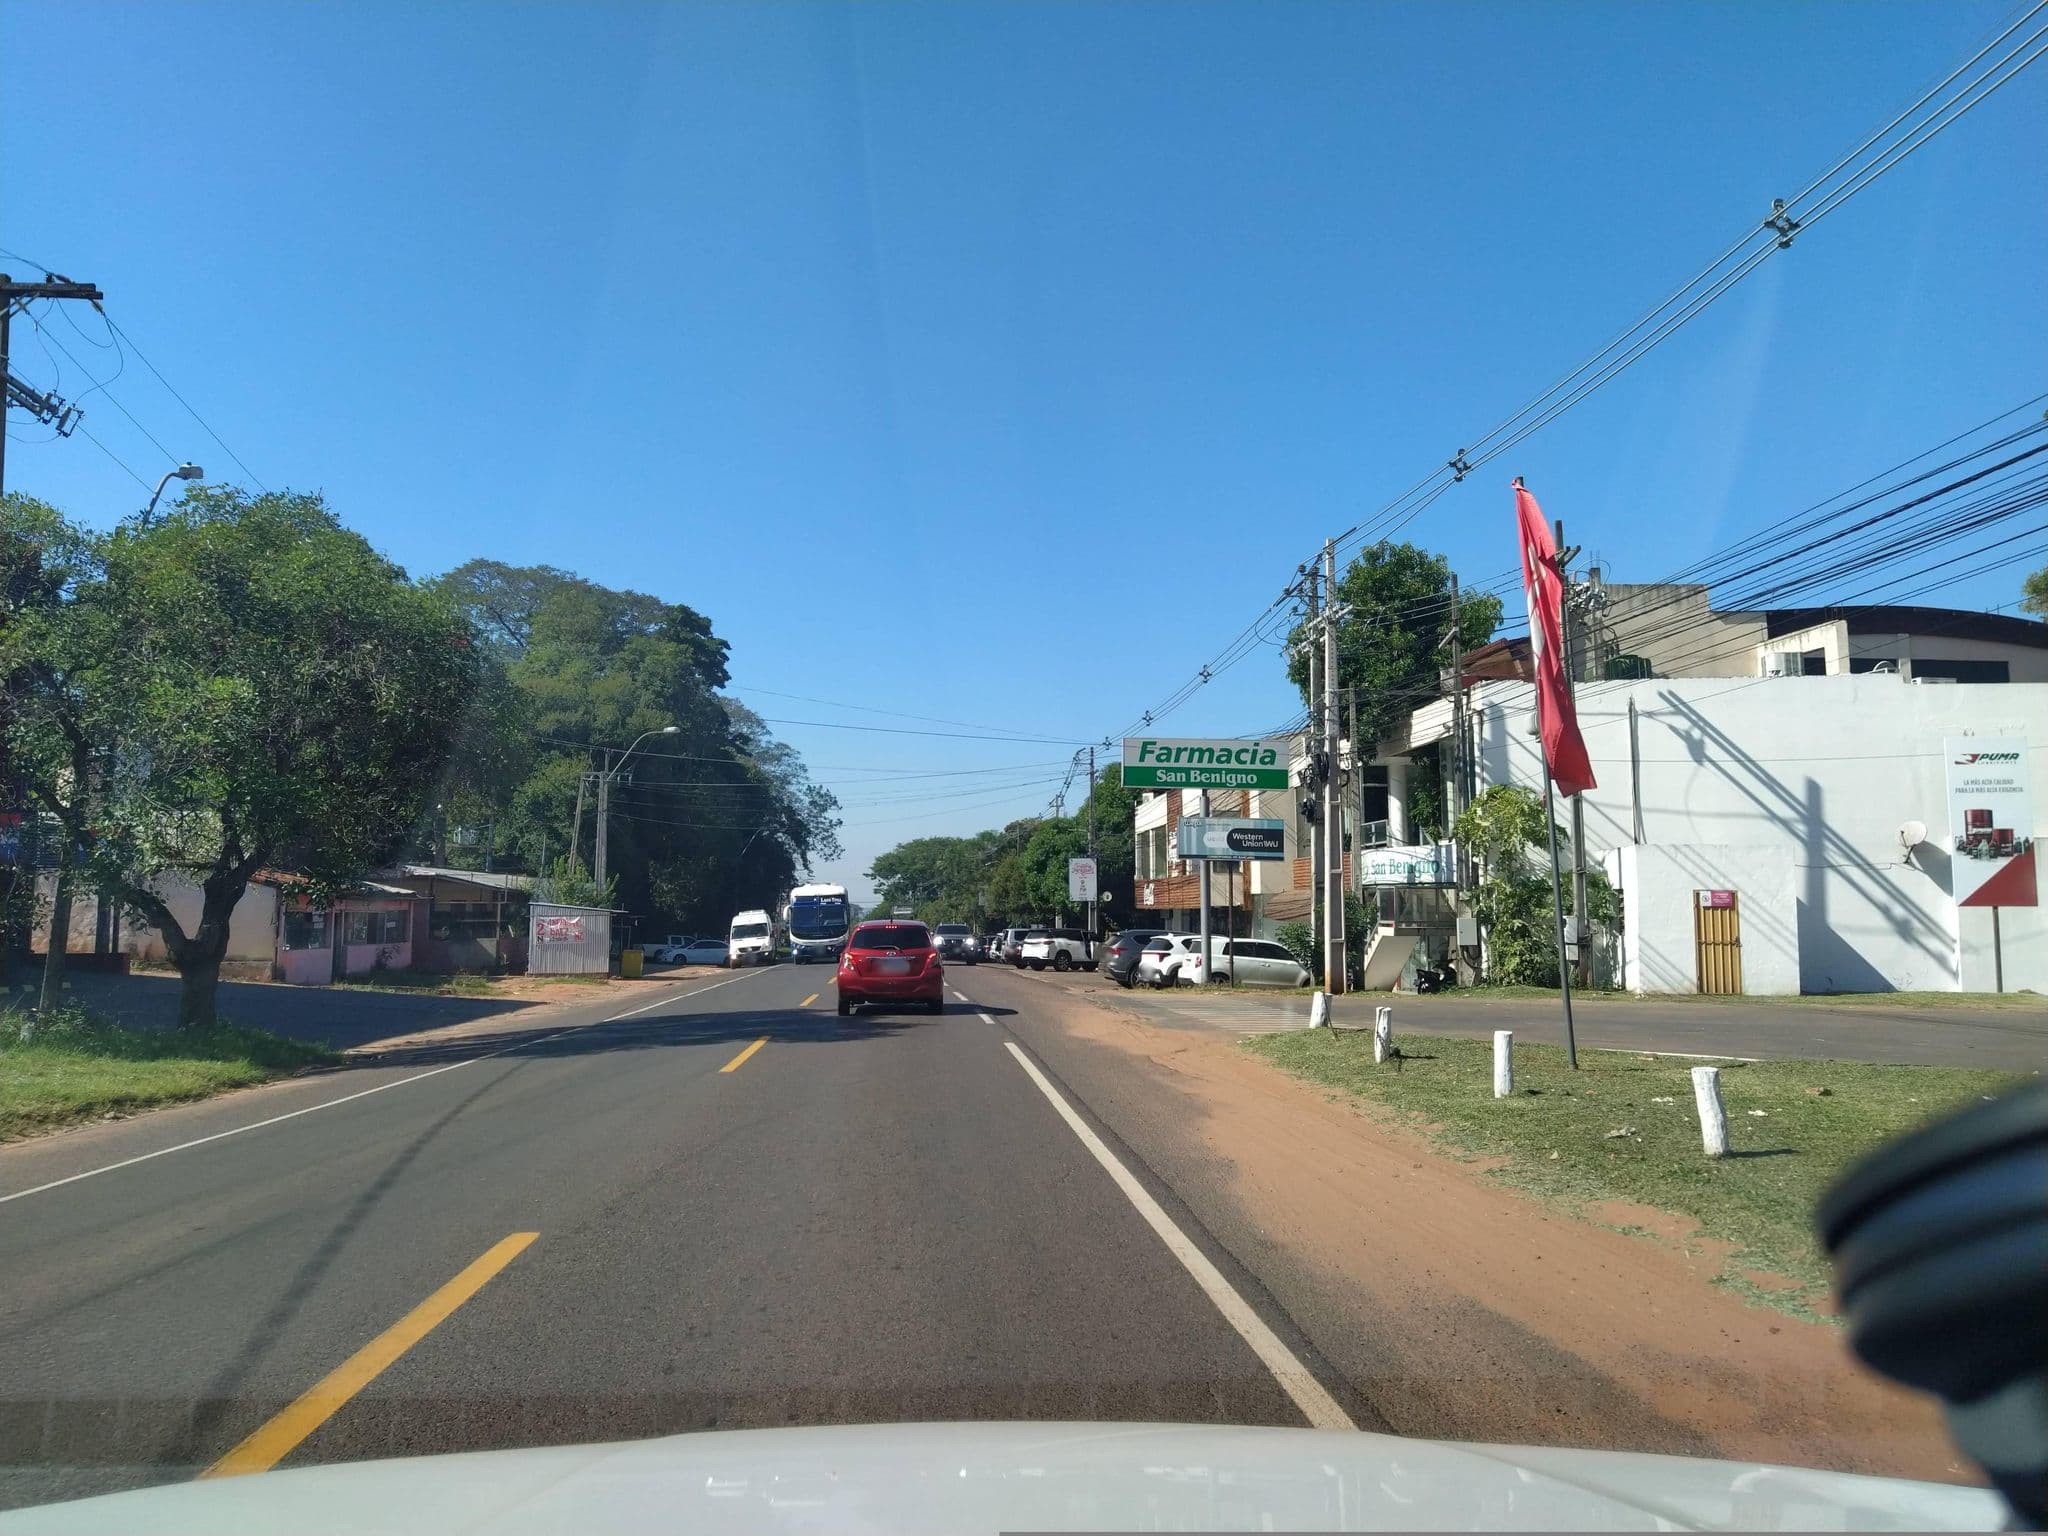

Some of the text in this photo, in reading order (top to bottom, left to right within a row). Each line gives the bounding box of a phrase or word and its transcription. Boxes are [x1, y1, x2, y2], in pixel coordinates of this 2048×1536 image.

[1138, 741, 1277, 766] Farmacia
[1979, 753, 2020, 761] PUMA
[1156, 769, 1258, 787] San Benigno
[1232, 832, 1264, 842] Western
[1242, 839, 1264, 848] Union
[1371, 858, 1440, 878] San Benigno
